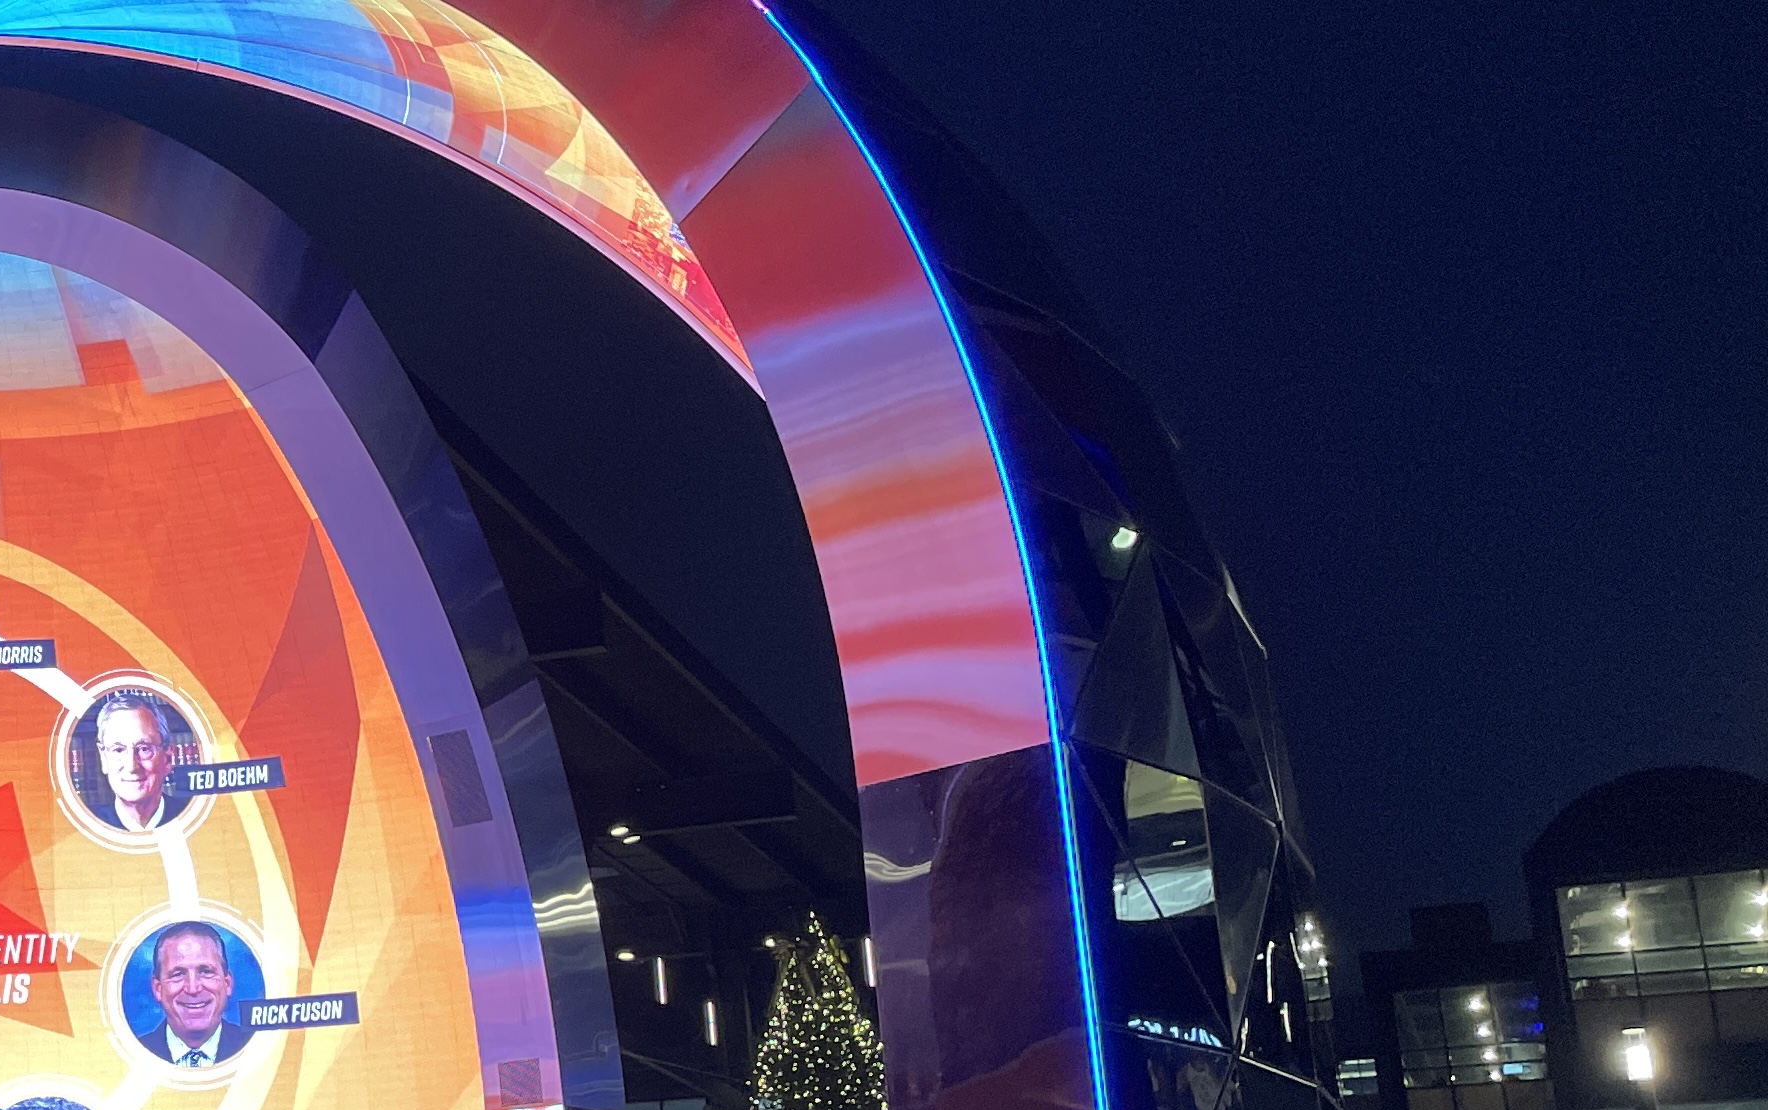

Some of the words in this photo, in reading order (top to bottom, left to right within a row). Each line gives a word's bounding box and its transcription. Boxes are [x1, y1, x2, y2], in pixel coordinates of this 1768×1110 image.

[187, 769, 215, 791] TED
[218, 764, 269, 788] BOEHM
[250, 1004, 290, 1026] RICK
[291, 1000, 343, 1023] FUSON
